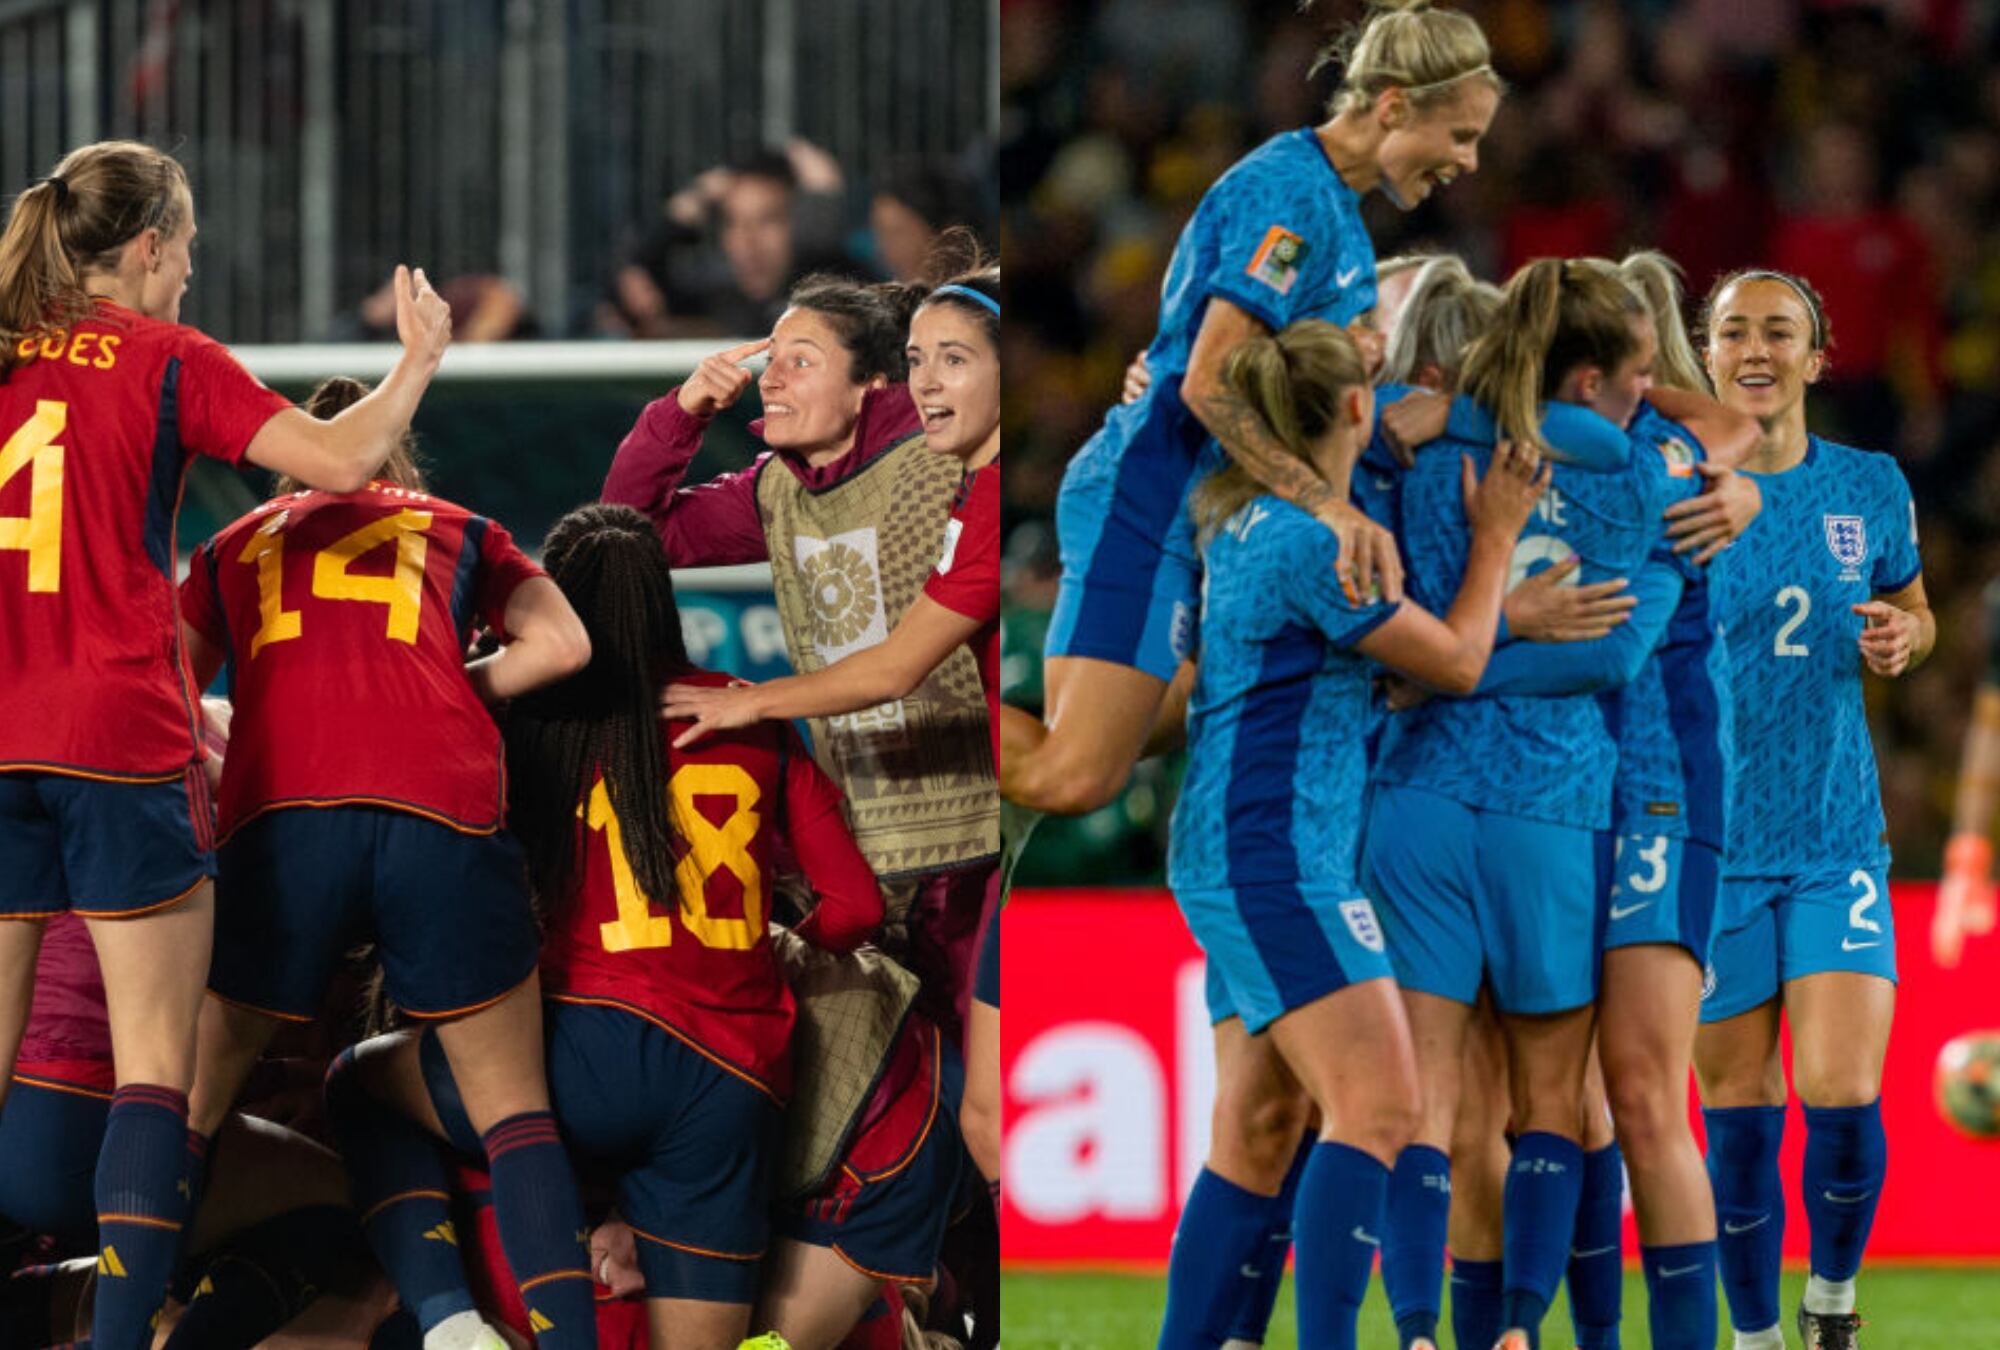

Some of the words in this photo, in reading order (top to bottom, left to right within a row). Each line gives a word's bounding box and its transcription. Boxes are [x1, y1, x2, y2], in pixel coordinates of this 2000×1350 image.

[0, 400, 67, 593] 4
[239, 508, 433, 659] 14
[1774, 586, 1811, 656] 2
[576, 764, 761, 953] 18
[1612, 833, 1668, 893] 3
[1849, 870, 1881, 933] 2
